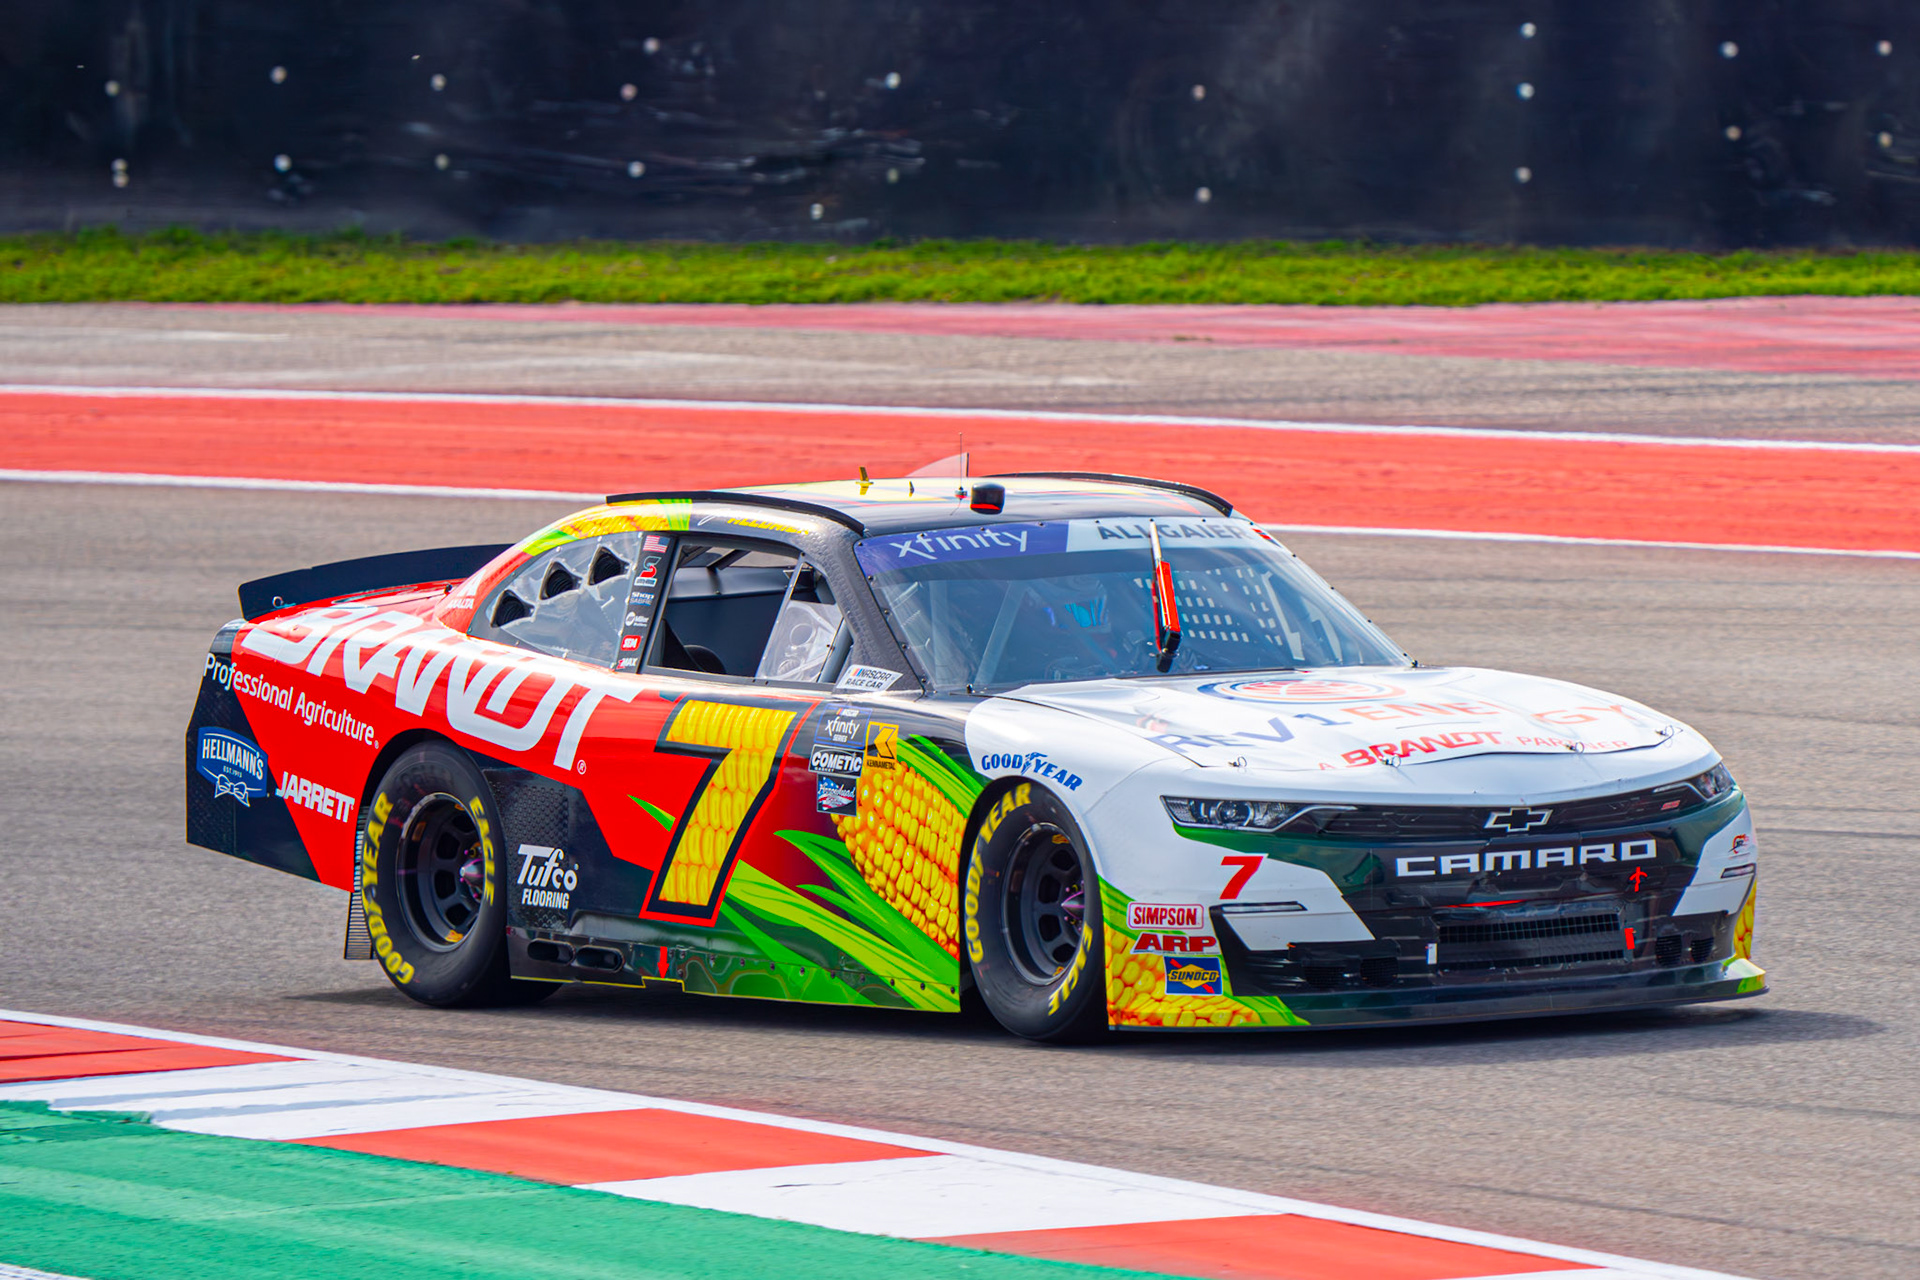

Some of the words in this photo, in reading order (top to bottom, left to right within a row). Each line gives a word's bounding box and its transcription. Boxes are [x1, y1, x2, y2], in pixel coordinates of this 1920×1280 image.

[889, 529, 1028, 560] xfinity
[203, 652, 293, 712] Professional
[294, 692, 375, 746] Agriculture
[241, 602, 646, 771] BRANDT
[845, 678, 864, 687] RACE
[865, 681, 884, 689] CAR
[825, 716, 860, 740] xfinity
[202, 738, 264, 781] HELLMANN'S
[811, 751, 863, 773] COMETIC
[866, 759, 897, 771] KENNAMETAL
[1318, 762, 1336, 770] A
[1341, 731, 1503, 768] BRANDT
[274, 771, 355, 823] JARRETT
[653, 697, 803, 915] 7
[517, 843, 579, 892] Tufco
[1397, 839, 1657, 877] CAMARO
[1219, 855, 1264, 900] 7
[521, 888, 570, 910] FLOORING
[1133, 906, 1198, 926] SIMPSON
[1134, 932, 1217, 953] ARP
[1170, 970, 1217, 981] SUNOCO
